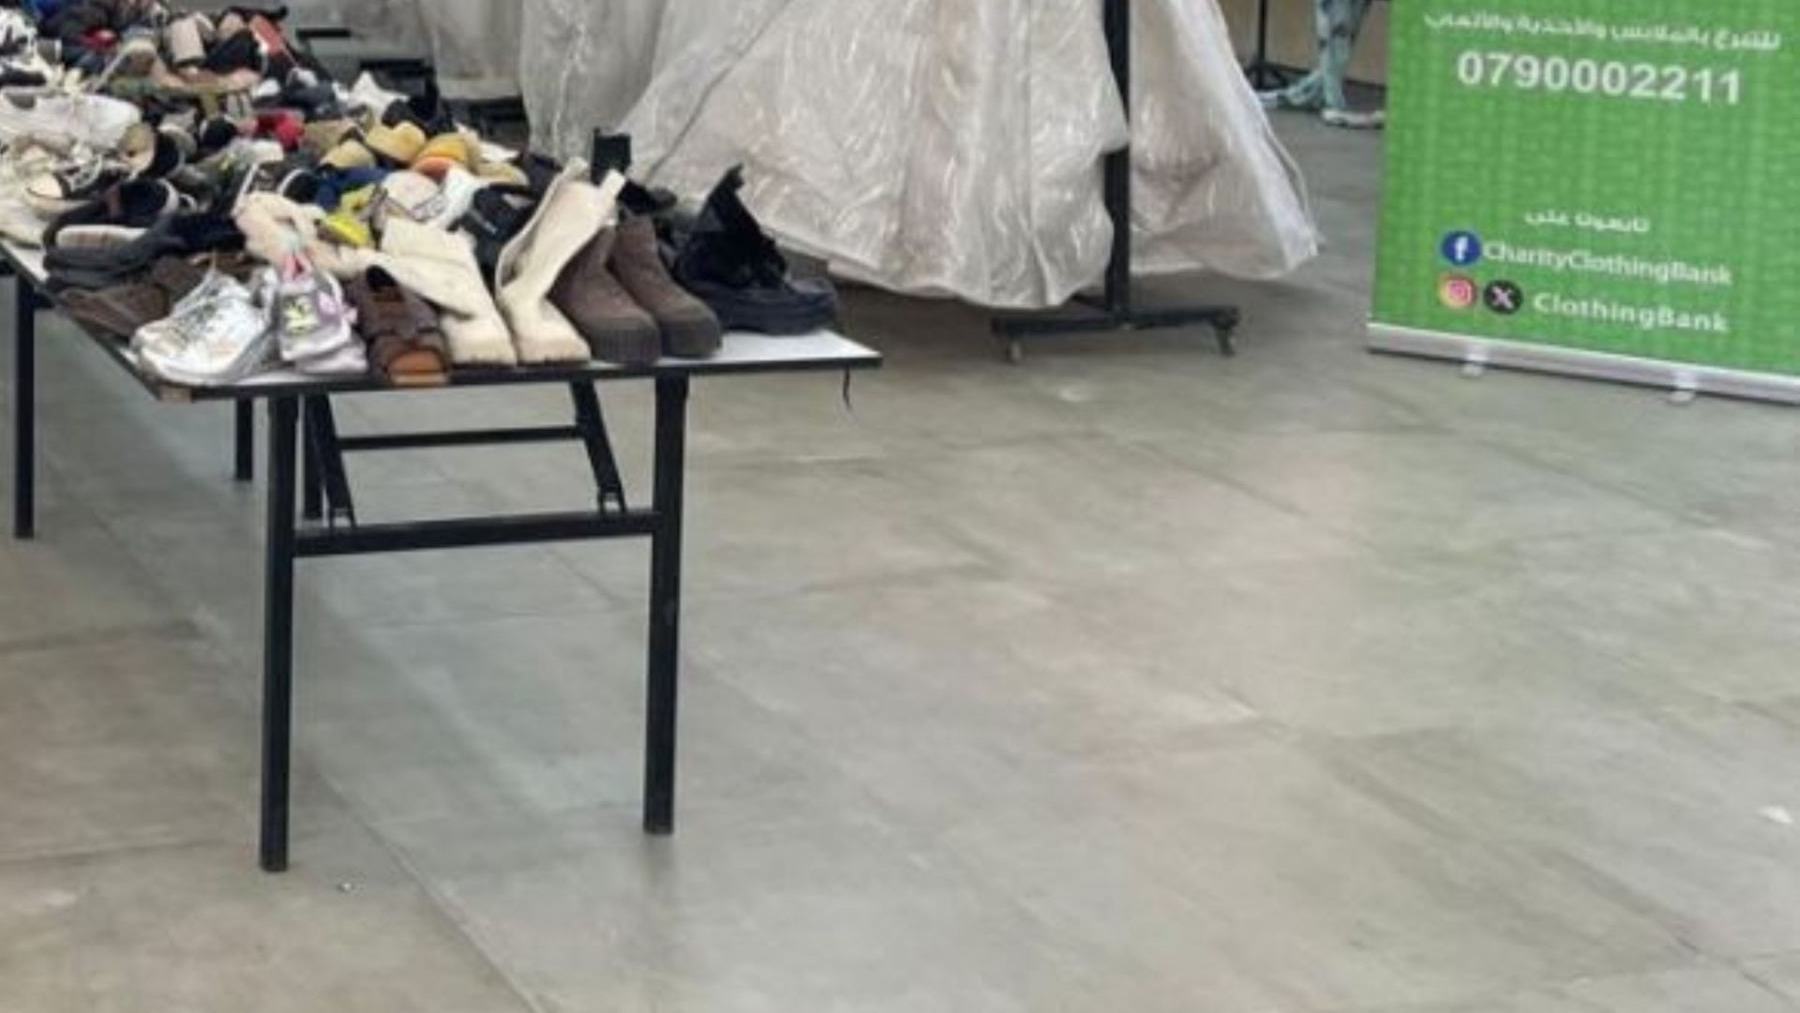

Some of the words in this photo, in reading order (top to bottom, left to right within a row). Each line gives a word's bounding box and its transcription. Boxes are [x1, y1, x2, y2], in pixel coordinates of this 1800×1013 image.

[1457, 49, 1741, 105] 0790002211
[1483, 239, 1734, 286] CharityClothingBank
[1533, 292, 1730, 333] ClothingBank
